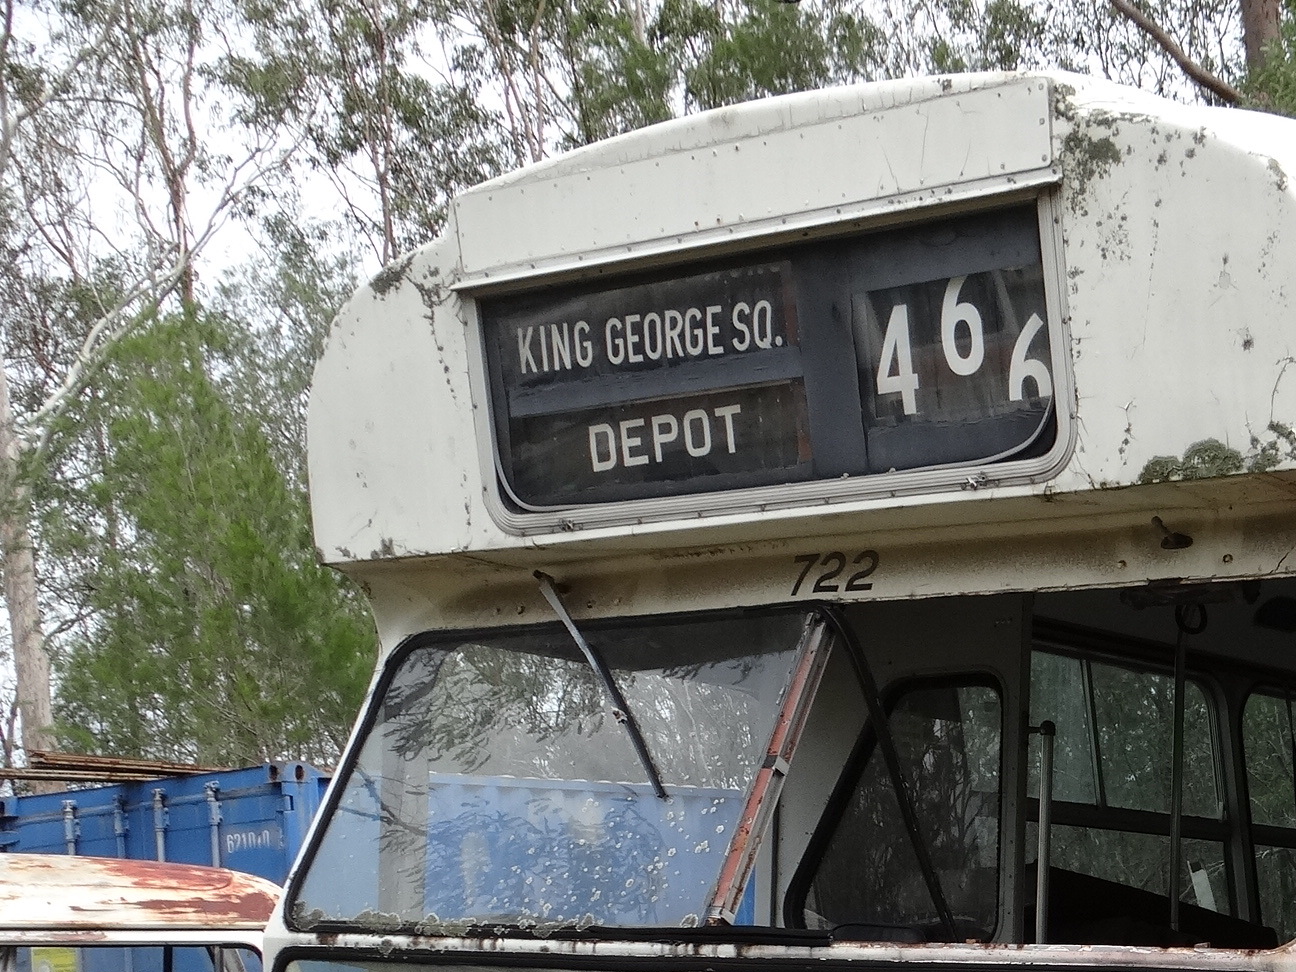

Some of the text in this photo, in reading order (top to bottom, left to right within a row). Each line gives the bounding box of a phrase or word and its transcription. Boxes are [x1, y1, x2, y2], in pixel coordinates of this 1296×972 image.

[516, 299, 784, 374] KING GEORGE SQ.
[589, 403, 742, 473] DEPOT
[790, 549, 880, 597] 722
